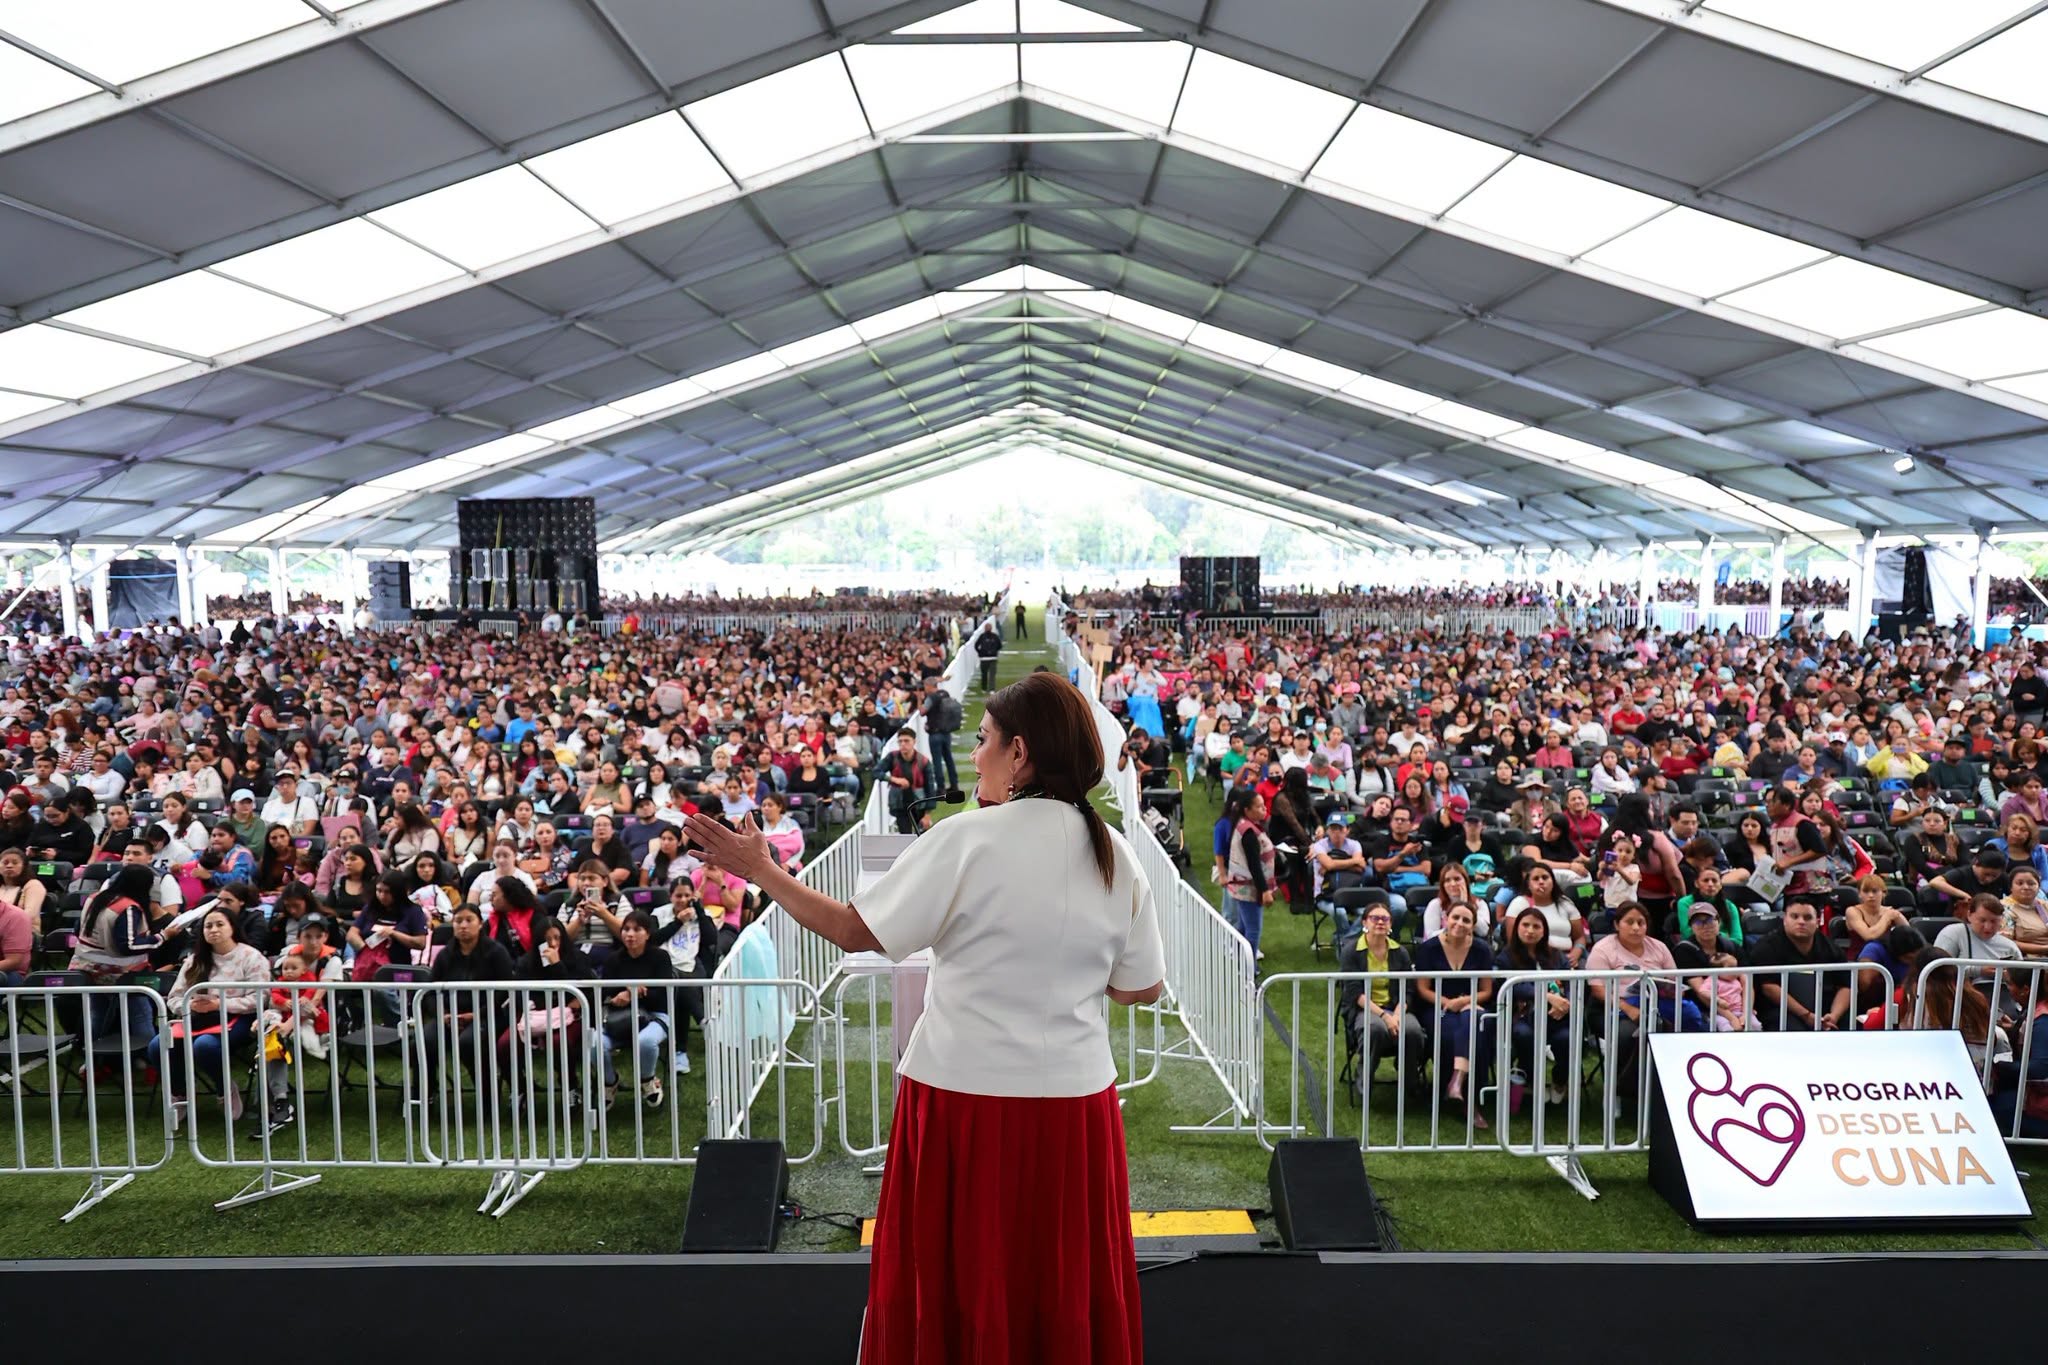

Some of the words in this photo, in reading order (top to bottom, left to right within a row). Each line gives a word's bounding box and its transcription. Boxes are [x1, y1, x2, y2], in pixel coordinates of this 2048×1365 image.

[1806, 1081, 1964, 1102] PROGRAMA
[1816, 1112, 1925, 1136] DESDE
[1930, 1111, 1977, 1135] LA
[1831, 1146, 1996, 1187] CUNA
